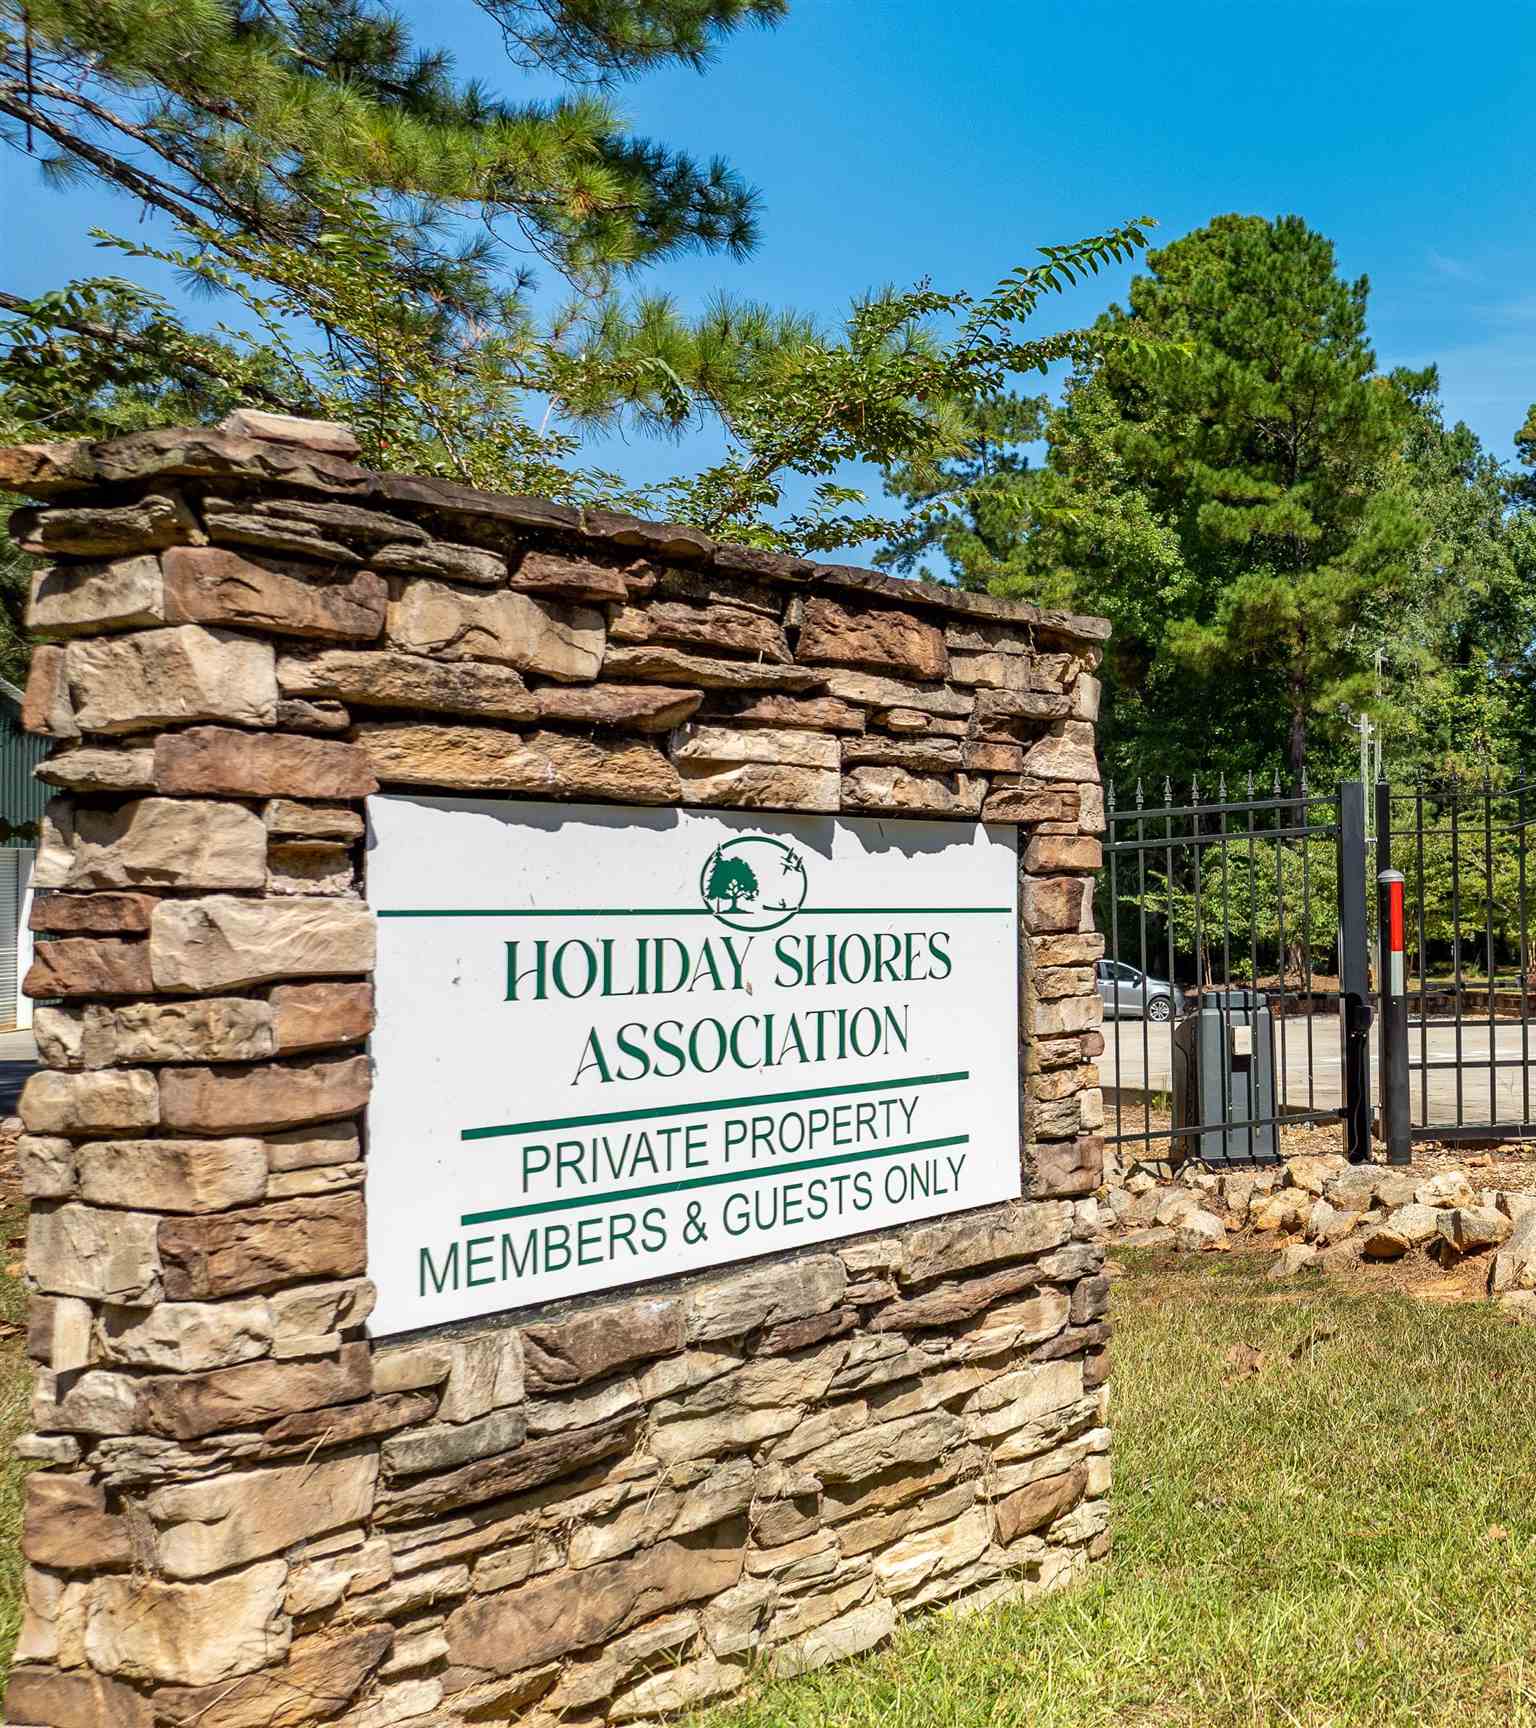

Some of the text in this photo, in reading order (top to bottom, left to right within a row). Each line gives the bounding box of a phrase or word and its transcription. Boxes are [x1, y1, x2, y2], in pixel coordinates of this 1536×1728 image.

[504, 932, 952, 1001] HOLIDAY SHORES
[571, 1005, 908, 1085] ASSOCIATION
[521, 1096, 919, 1192] PRIVATE PROPERTY
[419, 1154, 966, 1296] MEMBERS & GUESTS ONLY
